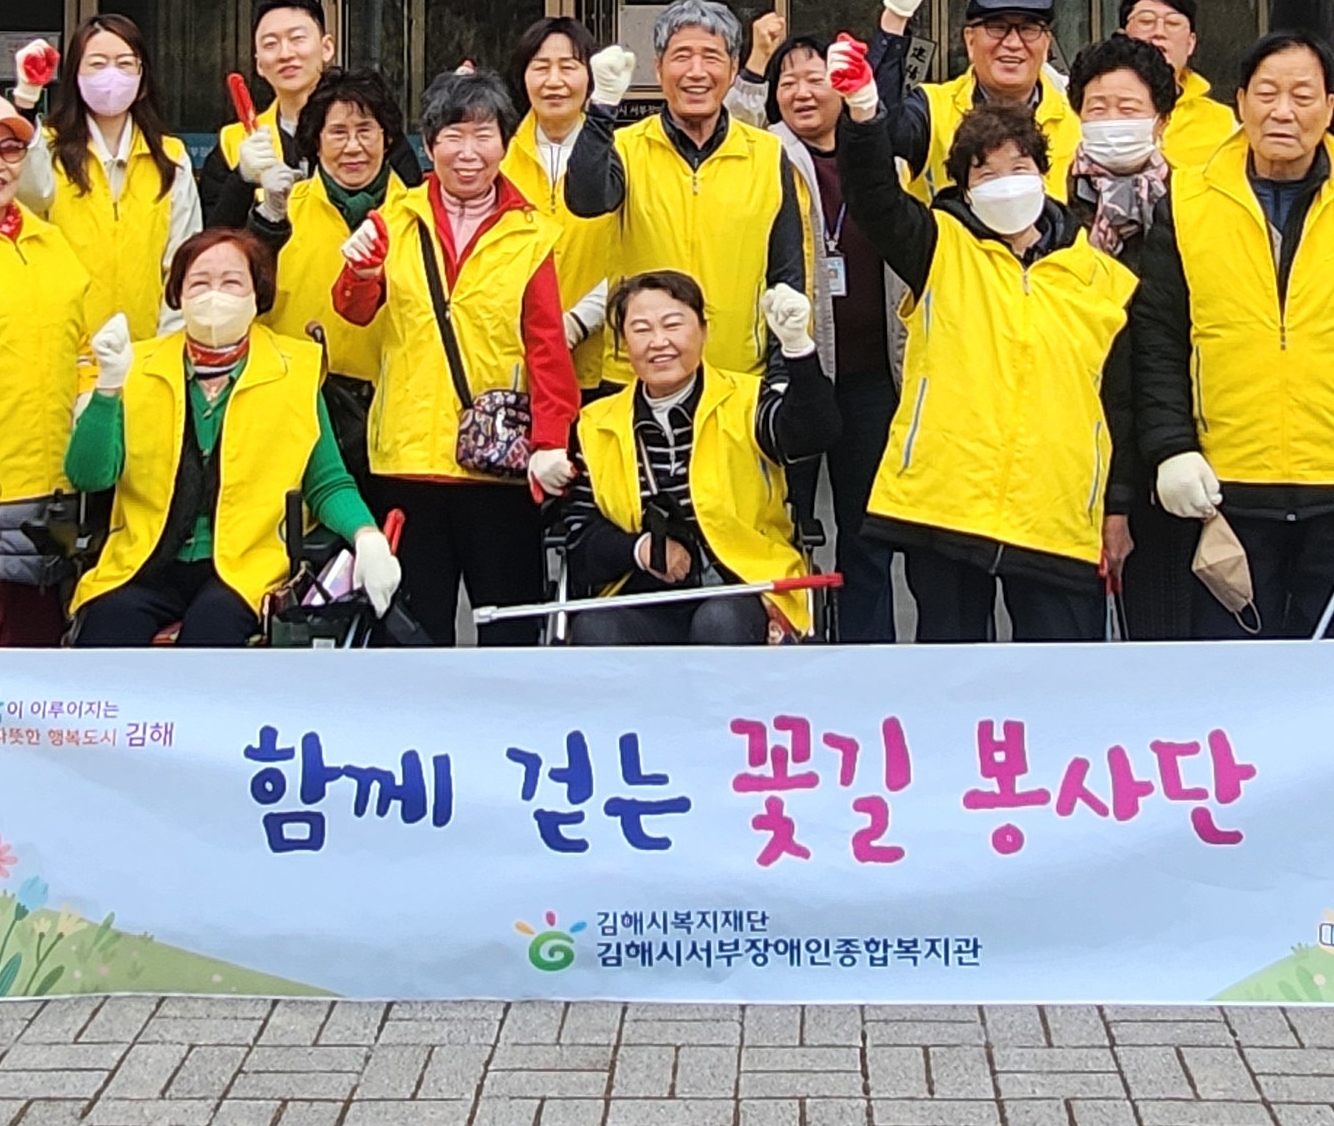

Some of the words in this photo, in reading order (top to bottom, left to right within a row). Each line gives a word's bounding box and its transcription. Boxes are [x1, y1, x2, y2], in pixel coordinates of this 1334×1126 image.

[30, 700, 119, 719] 이루어지는
[48, 727, 116, 746] 행복도시
[126, 721, 175, 747] 김해
[243, 726, 454, 854] 함께
[505, 730, 691, 853] 걷는
[729, 715, 912, 867] 꽃길
[961, 719, 1257, 856] 봉사단
[596, 910, 770, 936] 김해시복지재단
[596, 937, 983, 967] 김해시서부장애인종합복지관
